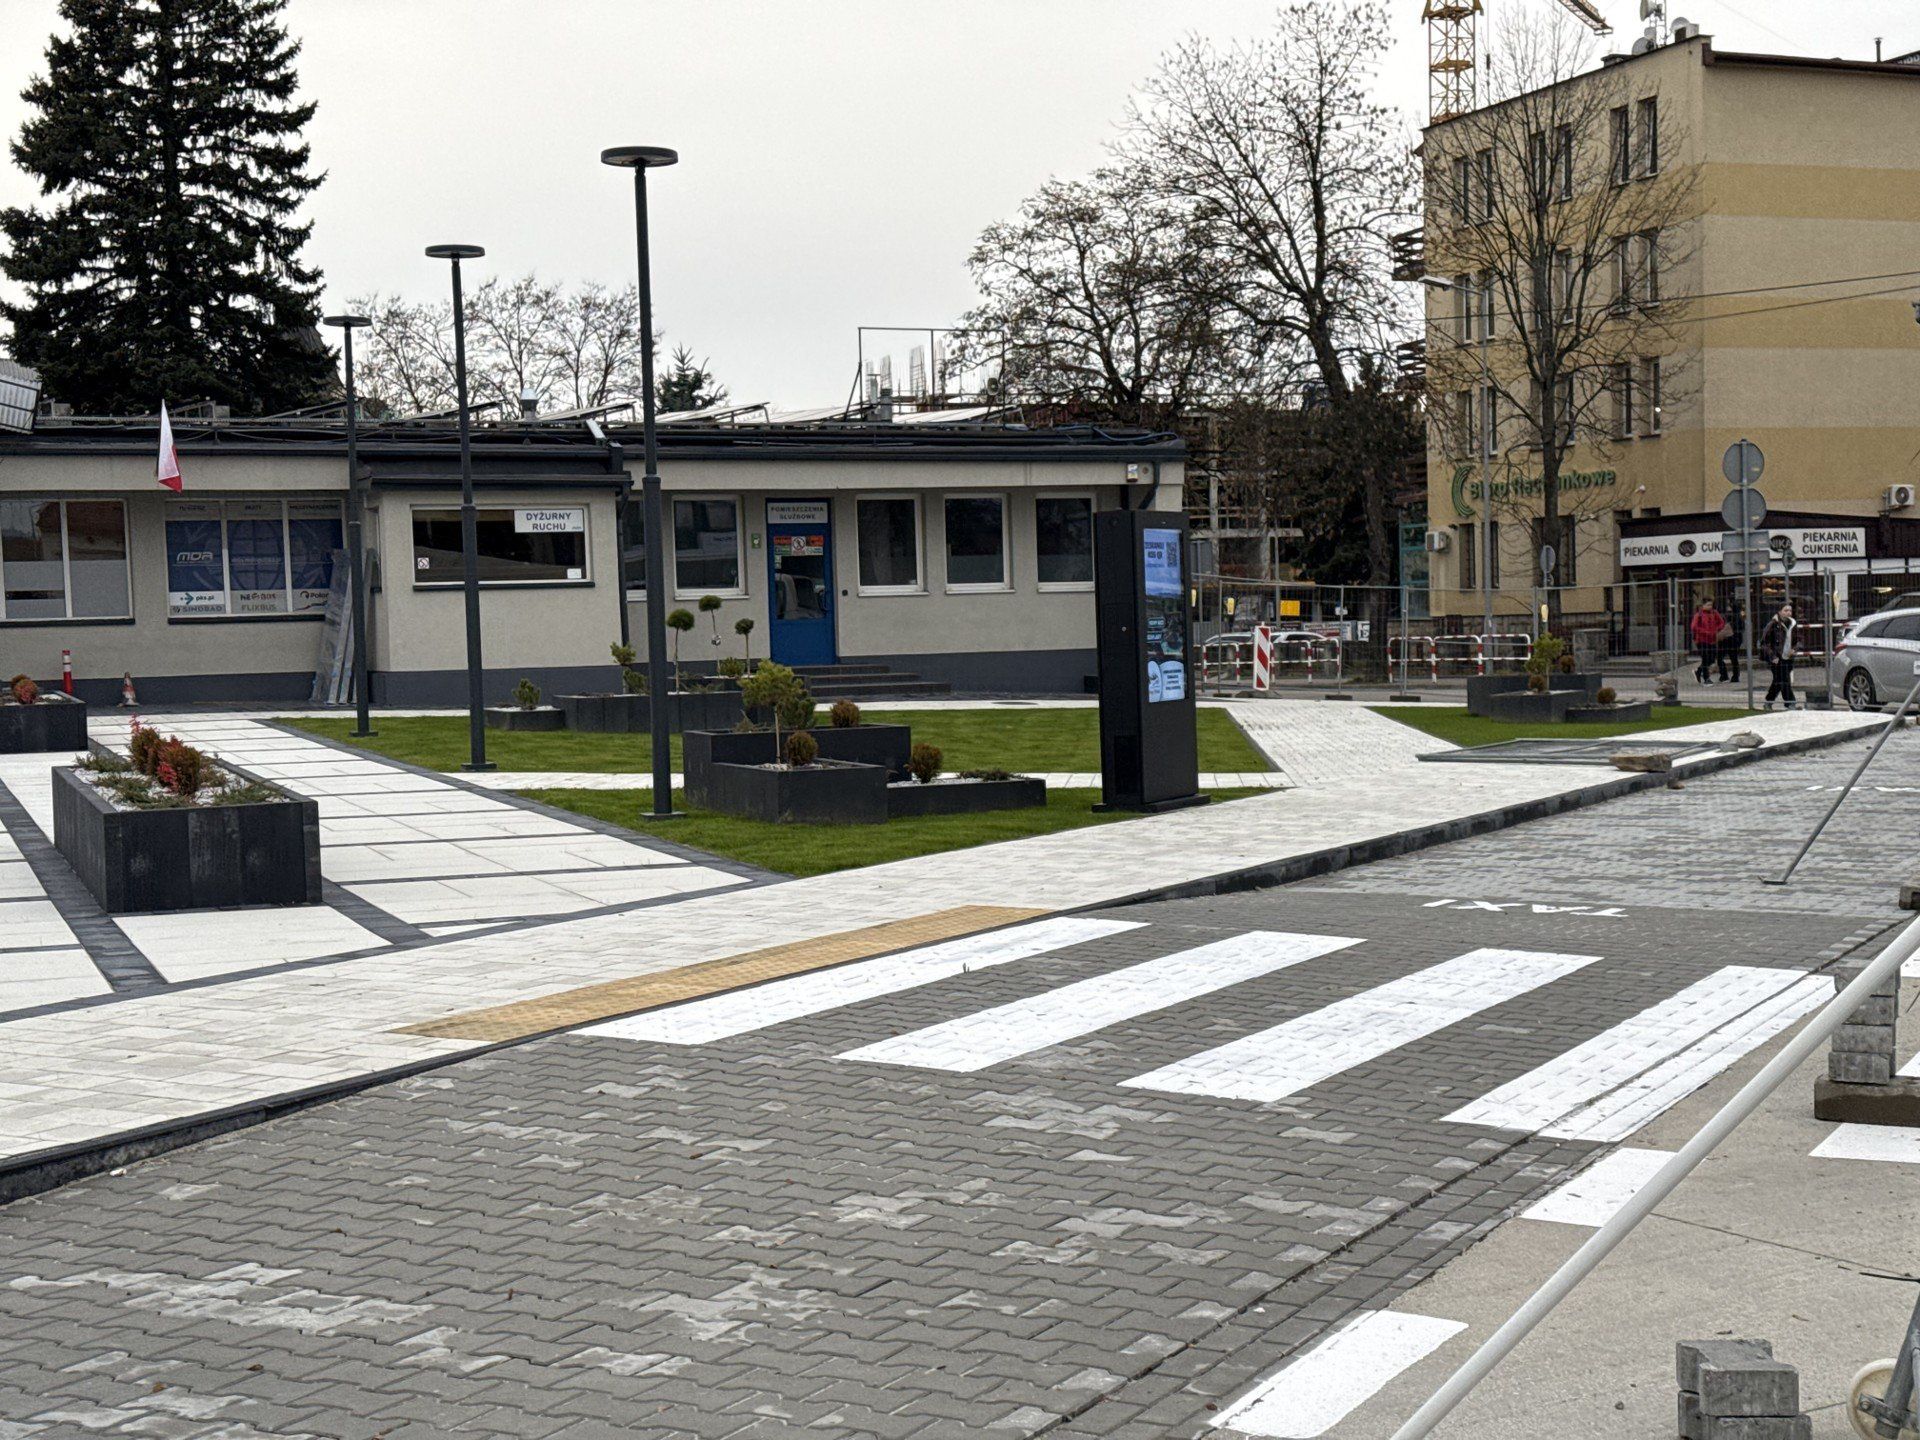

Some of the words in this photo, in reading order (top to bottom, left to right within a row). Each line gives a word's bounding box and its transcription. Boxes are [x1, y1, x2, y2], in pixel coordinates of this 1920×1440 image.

[526, 511, 571, 521] DYŻURNY
[532, 523, 566, 531] RUCHU
[1802, 532, 1859, 542] PIEKARNIA
[1624, 545, 1670, 557] PIEKARNIA
[1802, 544, 1859, 555] CUKIERNIA
[1421, 899, 1629, 918] TAXI
